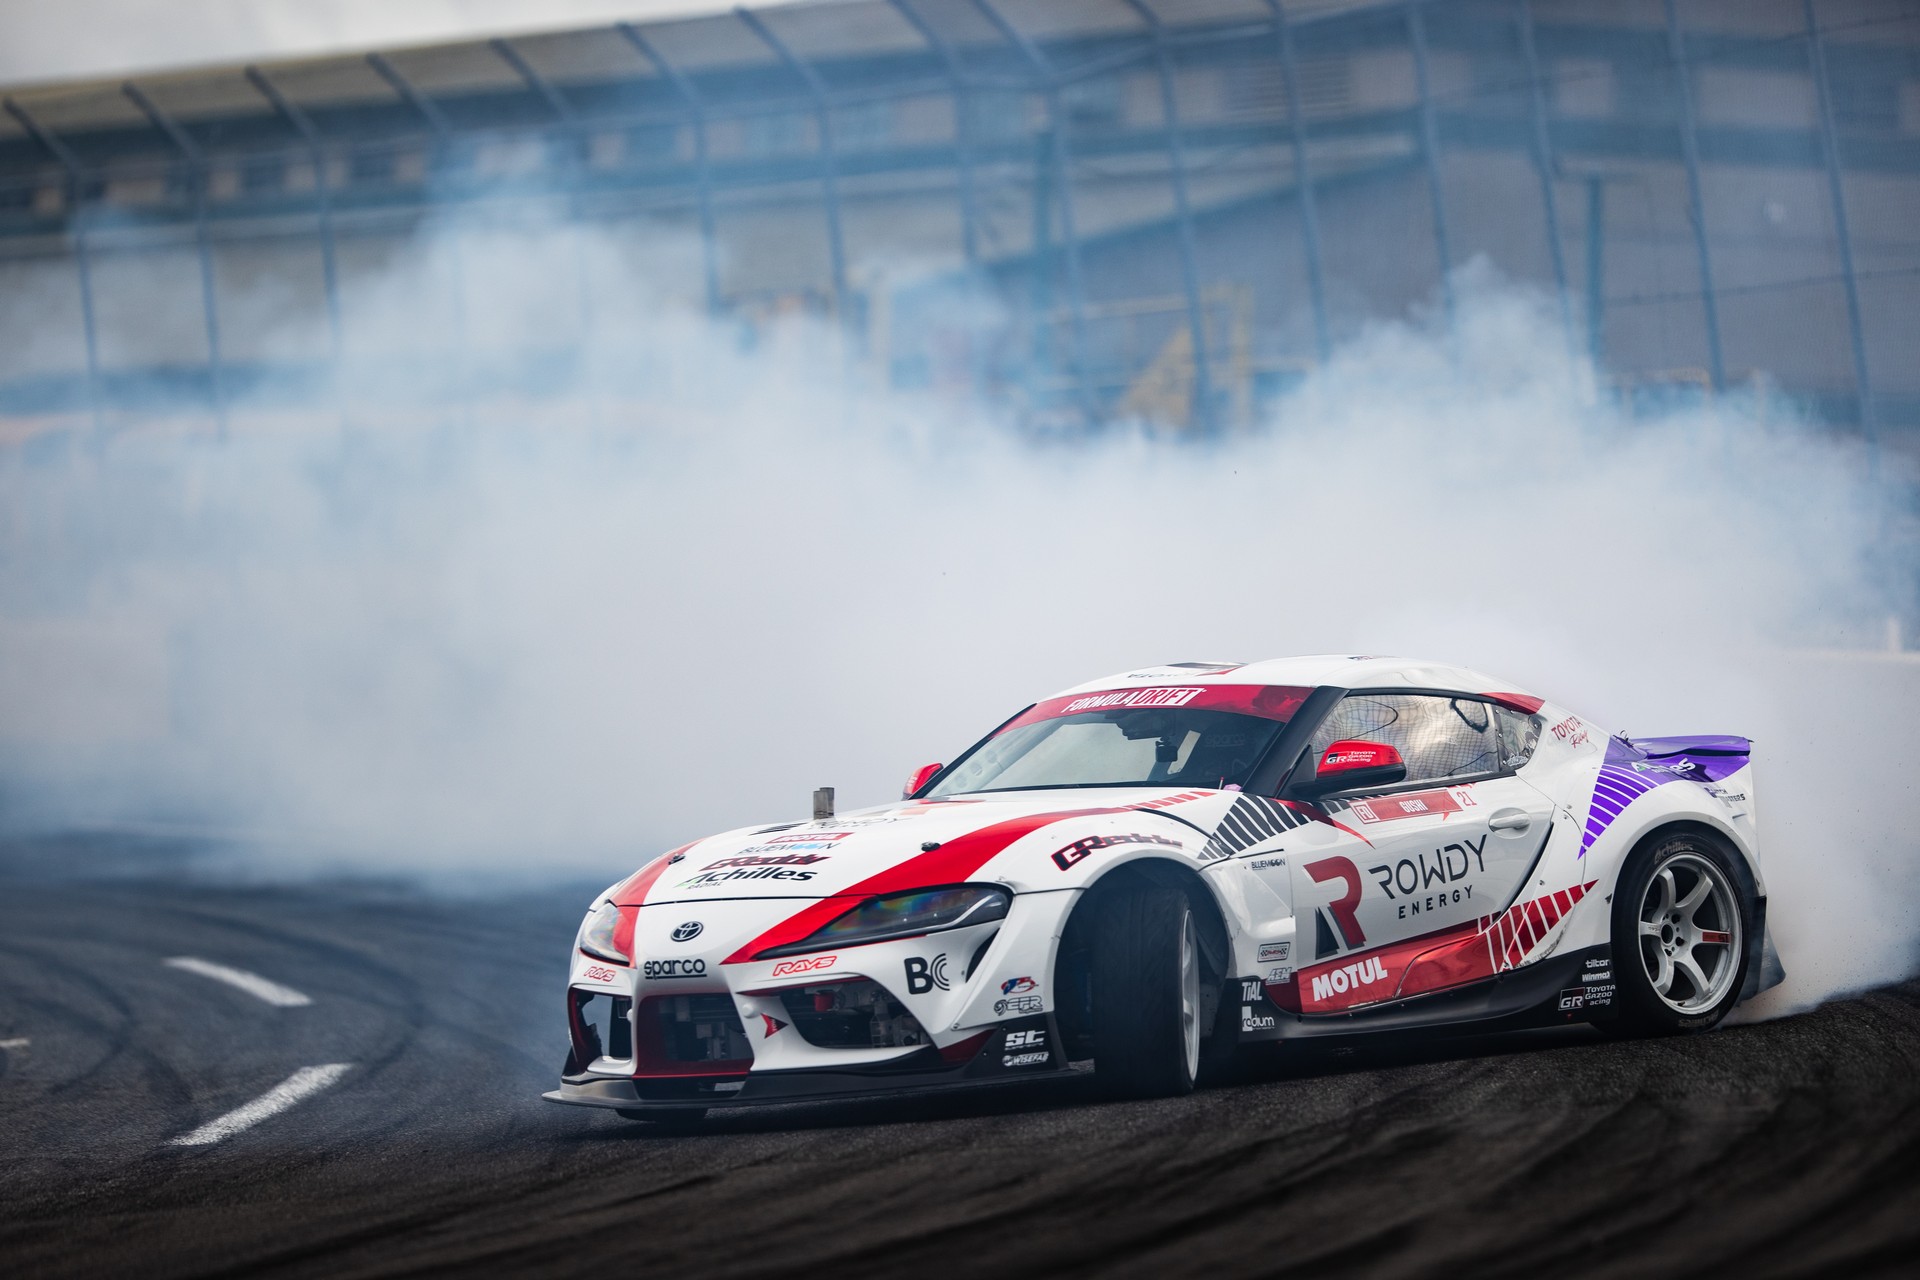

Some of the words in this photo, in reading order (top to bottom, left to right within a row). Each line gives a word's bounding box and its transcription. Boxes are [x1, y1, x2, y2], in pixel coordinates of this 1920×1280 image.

[1551, 715, 1584, 741] TOYOTA
[1326, 755, 1347, 765] GR
[1398, 799, 1429, 813] GUSHI
[1456, 791, 1478, 807] 21
[1368, 834, 1487, 899] ROWDY
[674, 867, 818, 888] Achilles
[1398, 885, 1473, 919] ENERGY
[584, 966, 617, 982] RAYS
[644, 958, 706, 980] sparco
[772, 956, 838, 977] RAYS
[1311, 956, 1388, 1001] MOTUL
[1585, 991, 1613, 1000] GAZOO
[1586, 984, 1616, 993] TOYOTA
[1560, 995, 1584, 1009] GR
